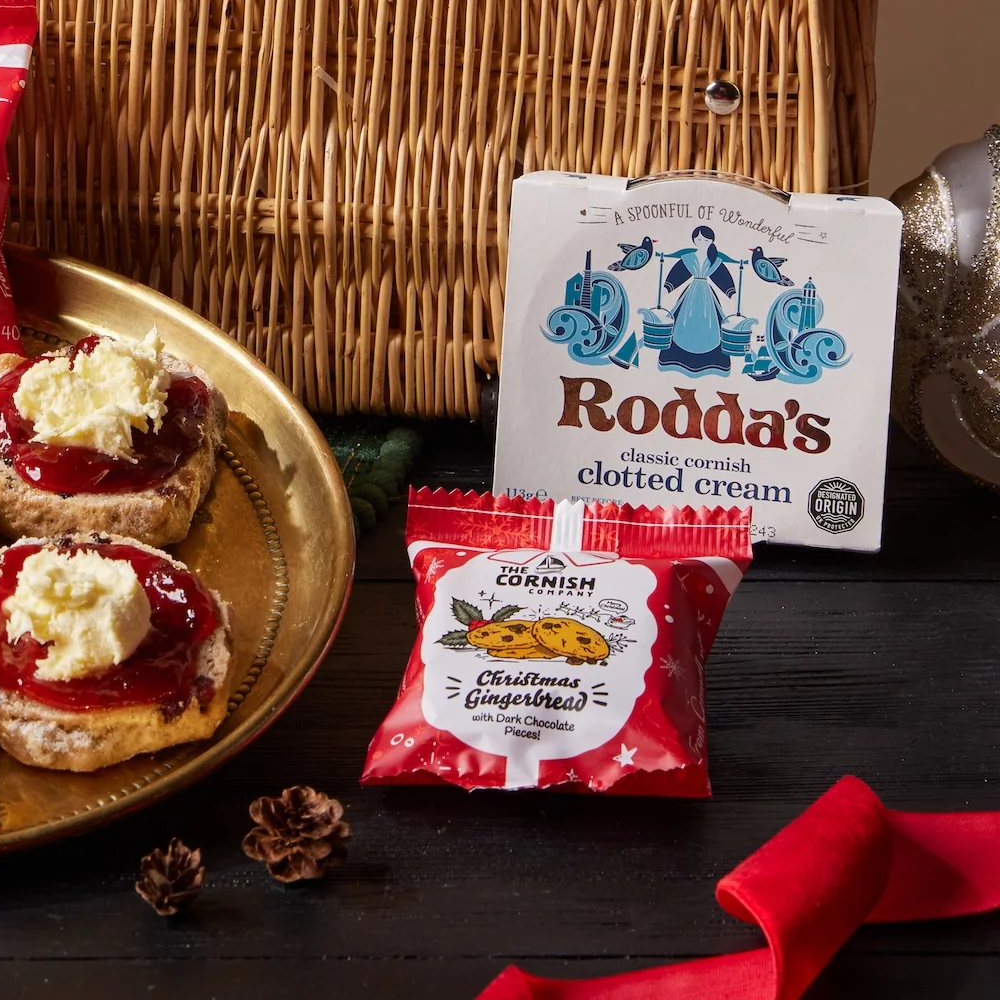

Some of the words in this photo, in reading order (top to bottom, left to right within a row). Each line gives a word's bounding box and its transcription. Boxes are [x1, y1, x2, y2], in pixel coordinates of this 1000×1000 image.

[614, 211, 624, 226] A
[627, 203, 693, 222] SPOONFUL
[698, 205, 715, 221] OF
[719, 208, 795, 245] Wonderful
[557, 375, 831, 455] Rodda's
[620, 448, 679, 467] classic
[684, 456, 752, 474] cornish
[577, 461, 684, 493] clotted
[694, 477, 793, 504] cream
[817, 490, 856, 502] DESIGNATED
[815, 499, 857, 515] ORIGIN
[823, 518, 855, 530] PROTECTED
[500, 566, 529, 574] THE
[496, 574, 596, 590] CORNISH
[528, 588, 594, 597] COMPANY
[476, 670, 581, 688] Christmas
[464, 688, 588, 712] Gingerbread
[472, 712, 494, 722] with
[496, 713, 522, 725] Dark
[524, 715, 575, 732] Chocolate
[504, 726, 541, 740] Pieces!
